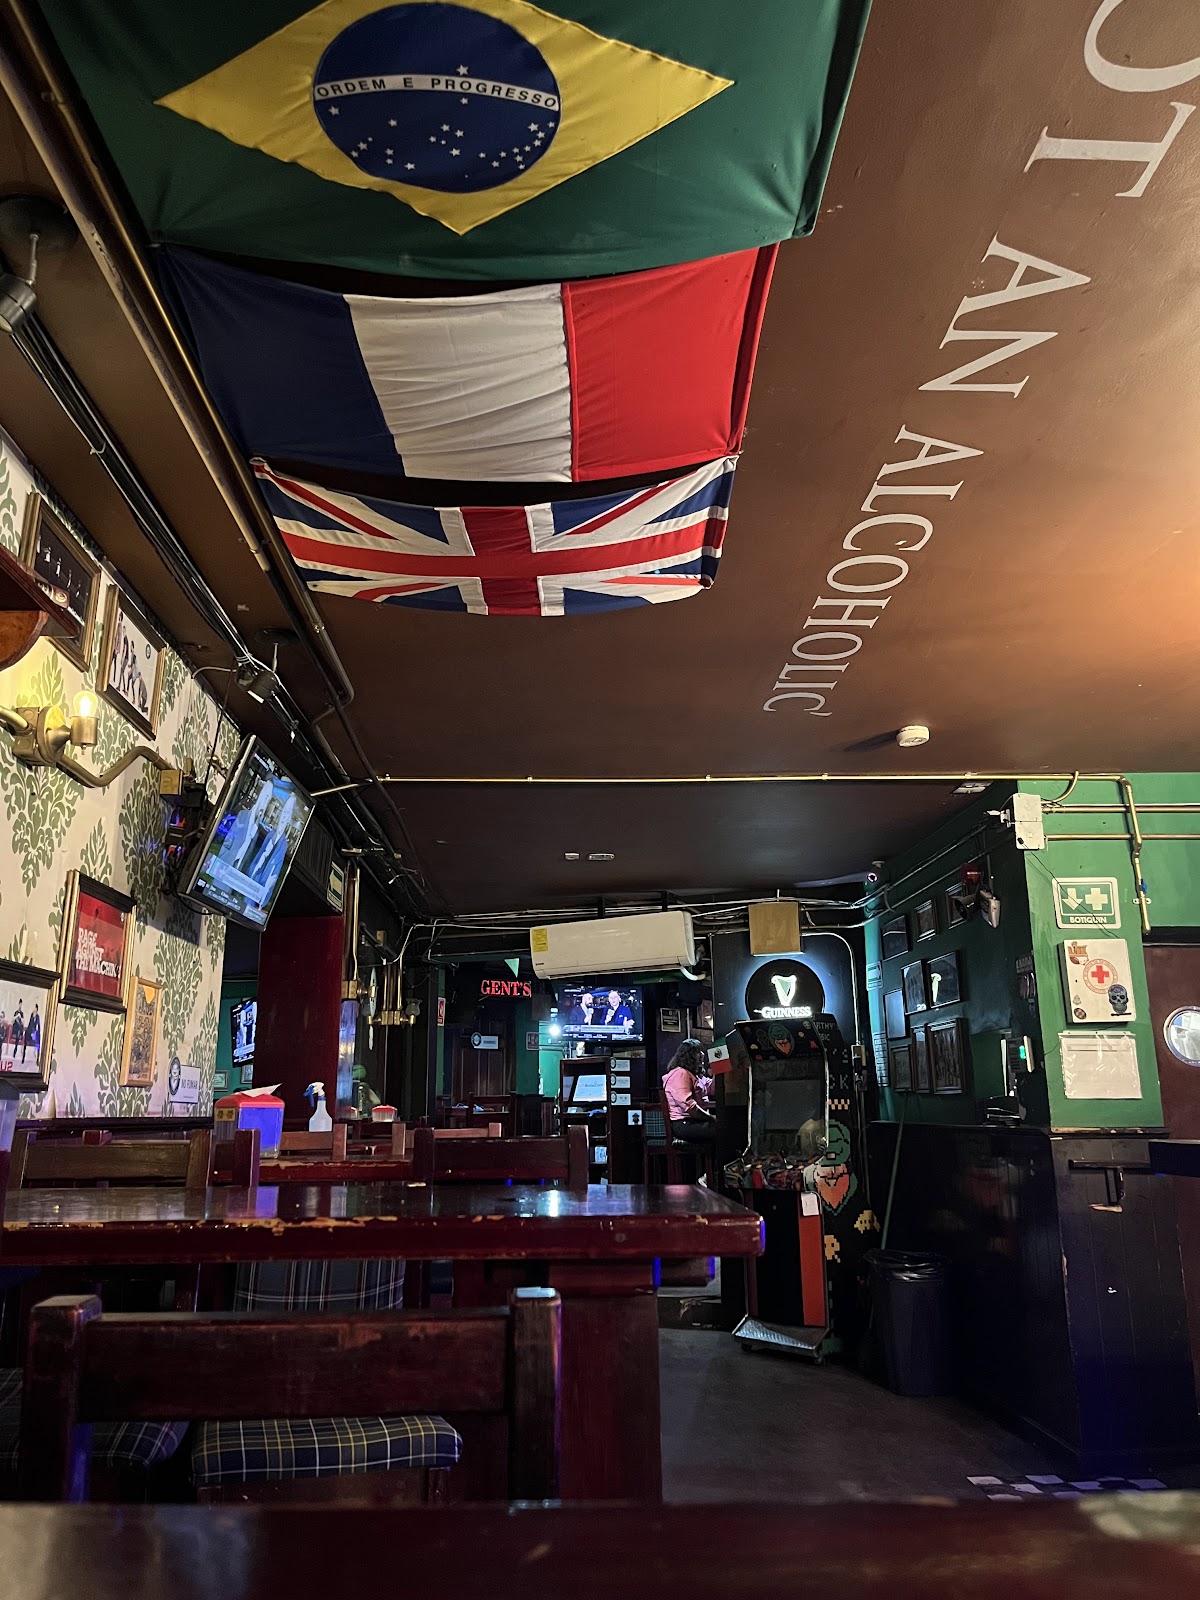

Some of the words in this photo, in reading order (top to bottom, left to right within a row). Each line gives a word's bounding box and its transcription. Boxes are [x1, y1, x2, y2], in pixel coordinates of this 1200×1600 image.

[317, 79, 386, 98] ORDEM
[403, 77, 414, 89] E
[431, 78, 557, 108] PROGRESSO
[918, 231, 1092, 399] AN
[1069, 916, 1108, 924] BOTIQUIN
[78, 927, 98, 945] RAGE
[76, 942, 105, 961] AGAINST
[75, 957, 90, 971] THE
[481, 979, 532, 997] GENT'S
[761, 1006, 812, 1019] GUINNESS
[0, 1060, 13, 1072] U2
